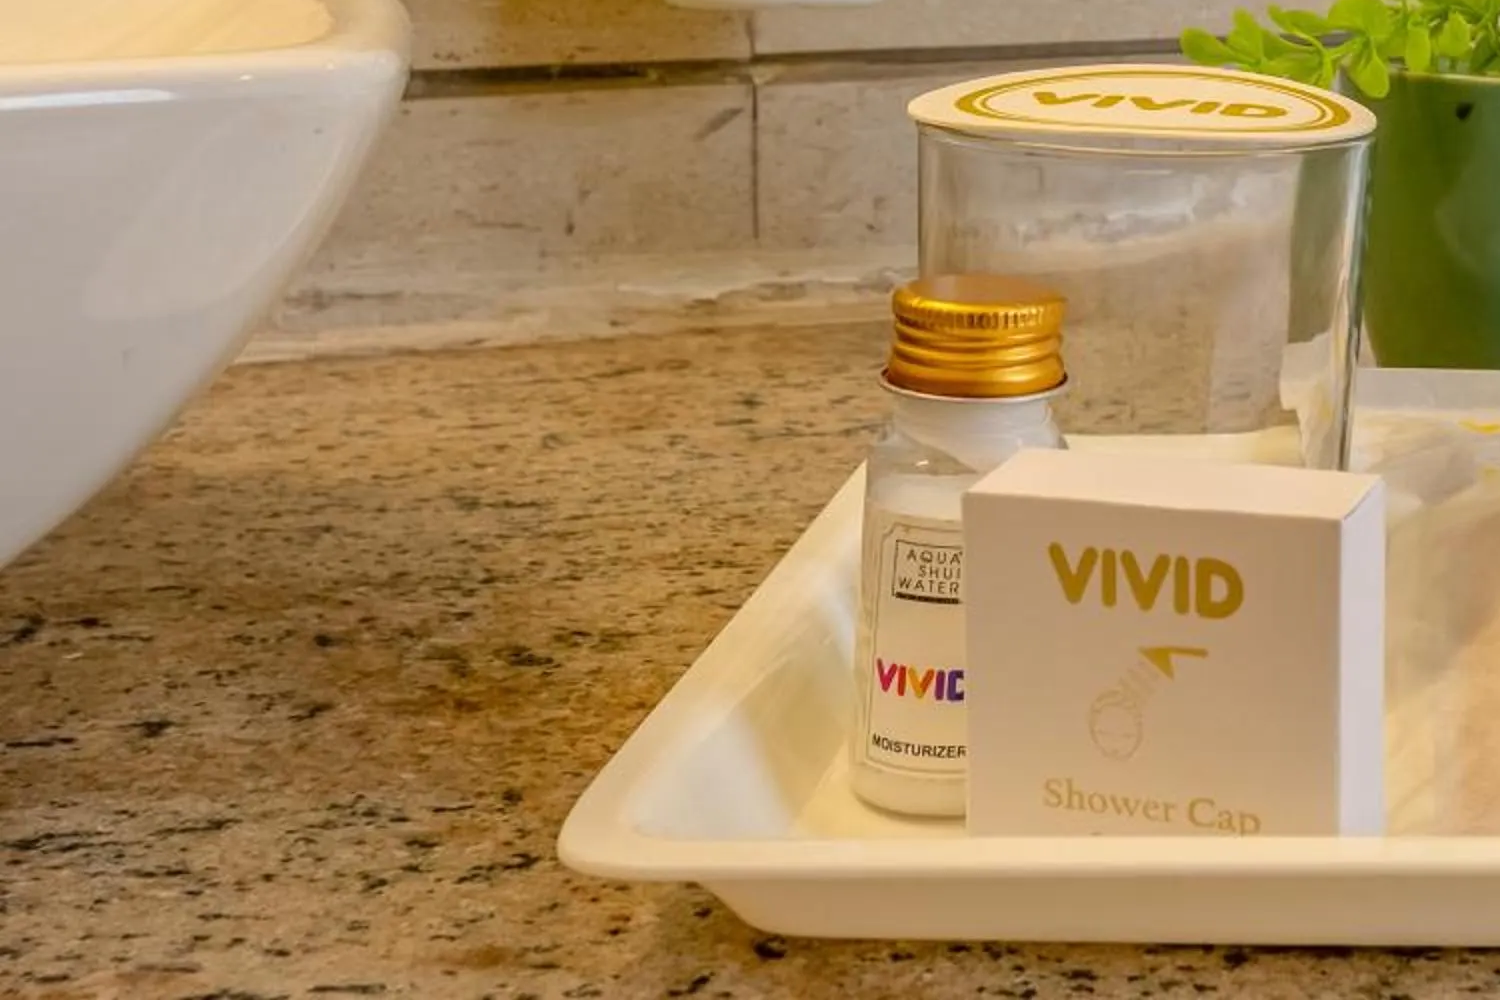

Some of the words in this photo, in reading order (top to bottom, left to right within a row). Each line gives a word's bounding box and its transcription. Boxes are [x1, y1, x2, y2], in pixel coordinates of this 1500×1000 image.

[1033, 90, 1288, 119] VIVID
[906, 548, 961, 566] AQUA
[898, 576, 960, 595] WATER
[918, 564, 961, 581] SHUI
[1048, 540, 1244, 620] VIVID
[871, 732, 967, 760] MOISTURIZER
[1043, 777, 1177, 824] Shower
[1187, 797, 1262, 837] Cap
